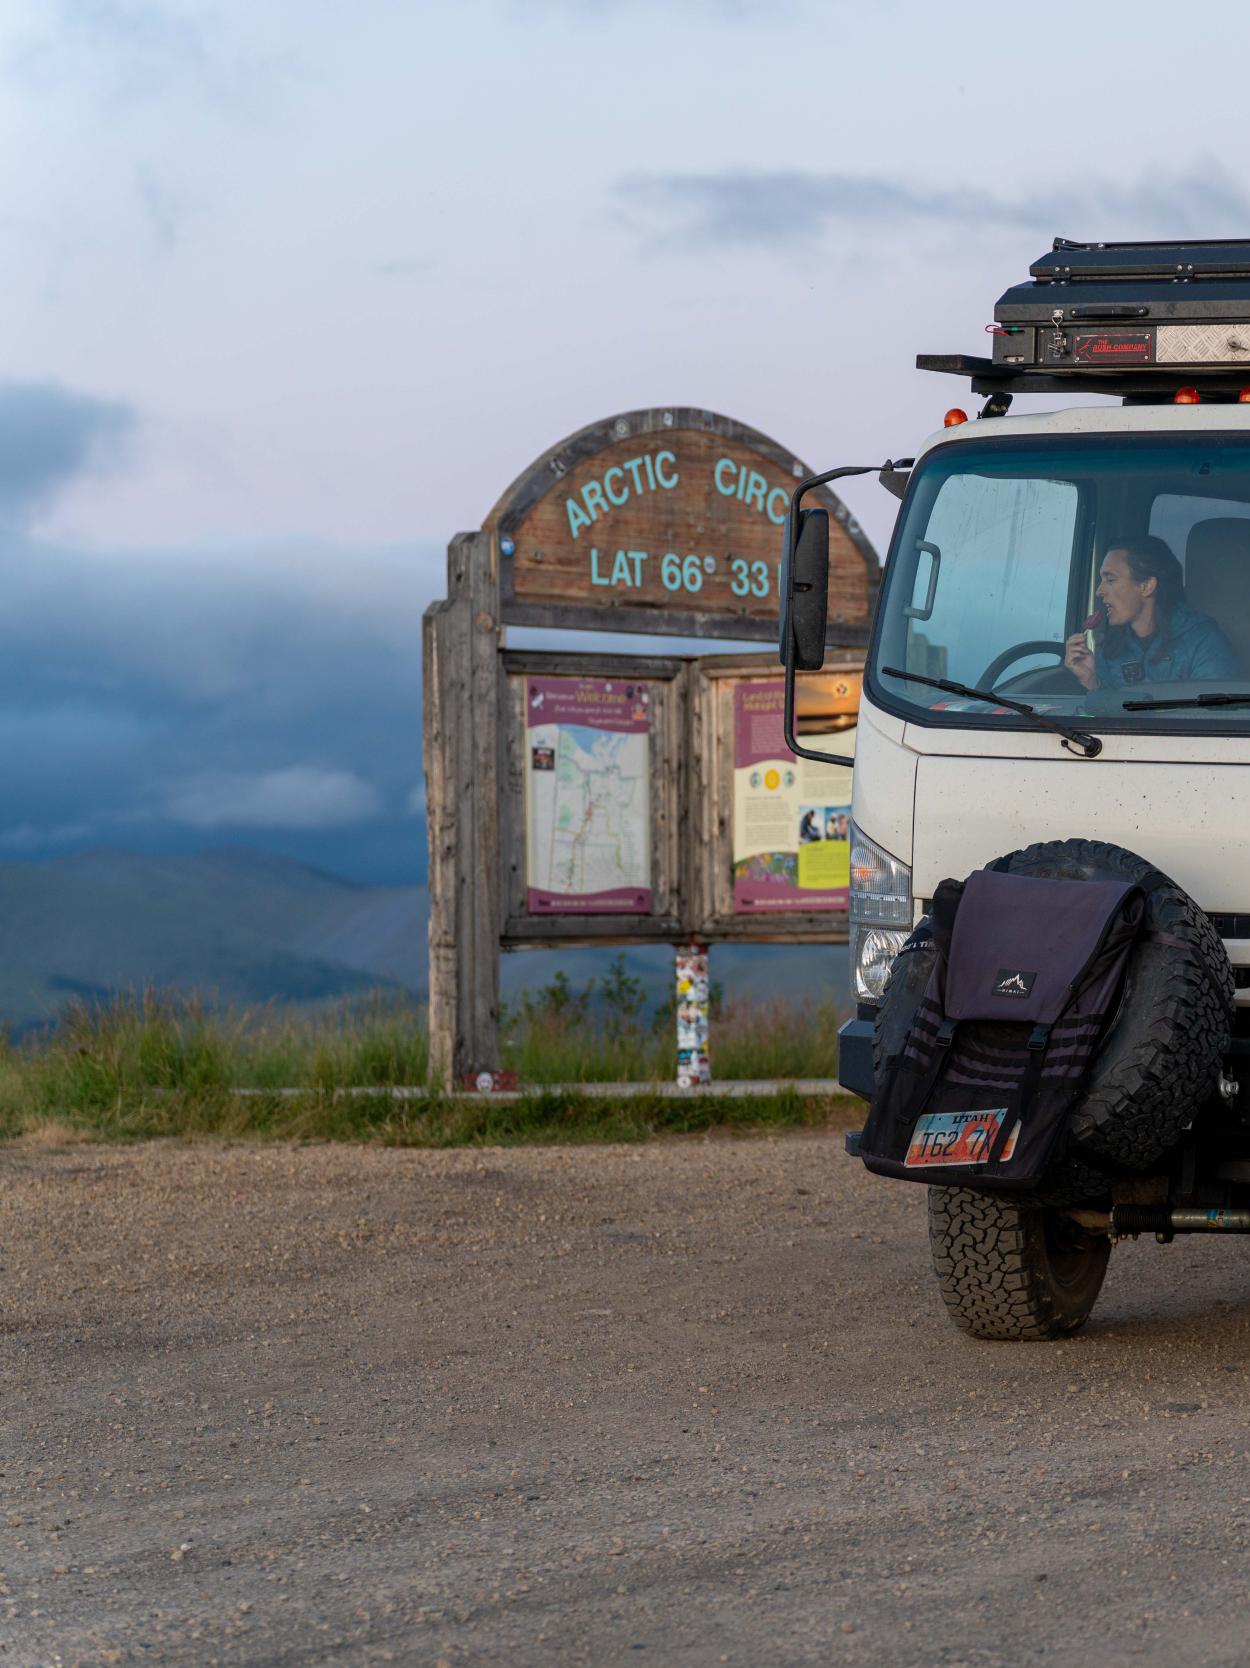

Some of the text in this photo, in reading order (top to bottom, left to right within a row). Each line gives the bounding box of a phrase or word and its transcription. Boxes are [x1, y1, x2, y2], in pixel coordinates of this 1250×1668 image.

[1113, 343, 1147, 351] COMPANY
[565, 450, 791, 539] ARCTIC CIRC
[590, 548, 648, 588] LAT
[952, 1113, 989, 1125] UTAH
[919, 1129, 997, 1158] T62 7X
